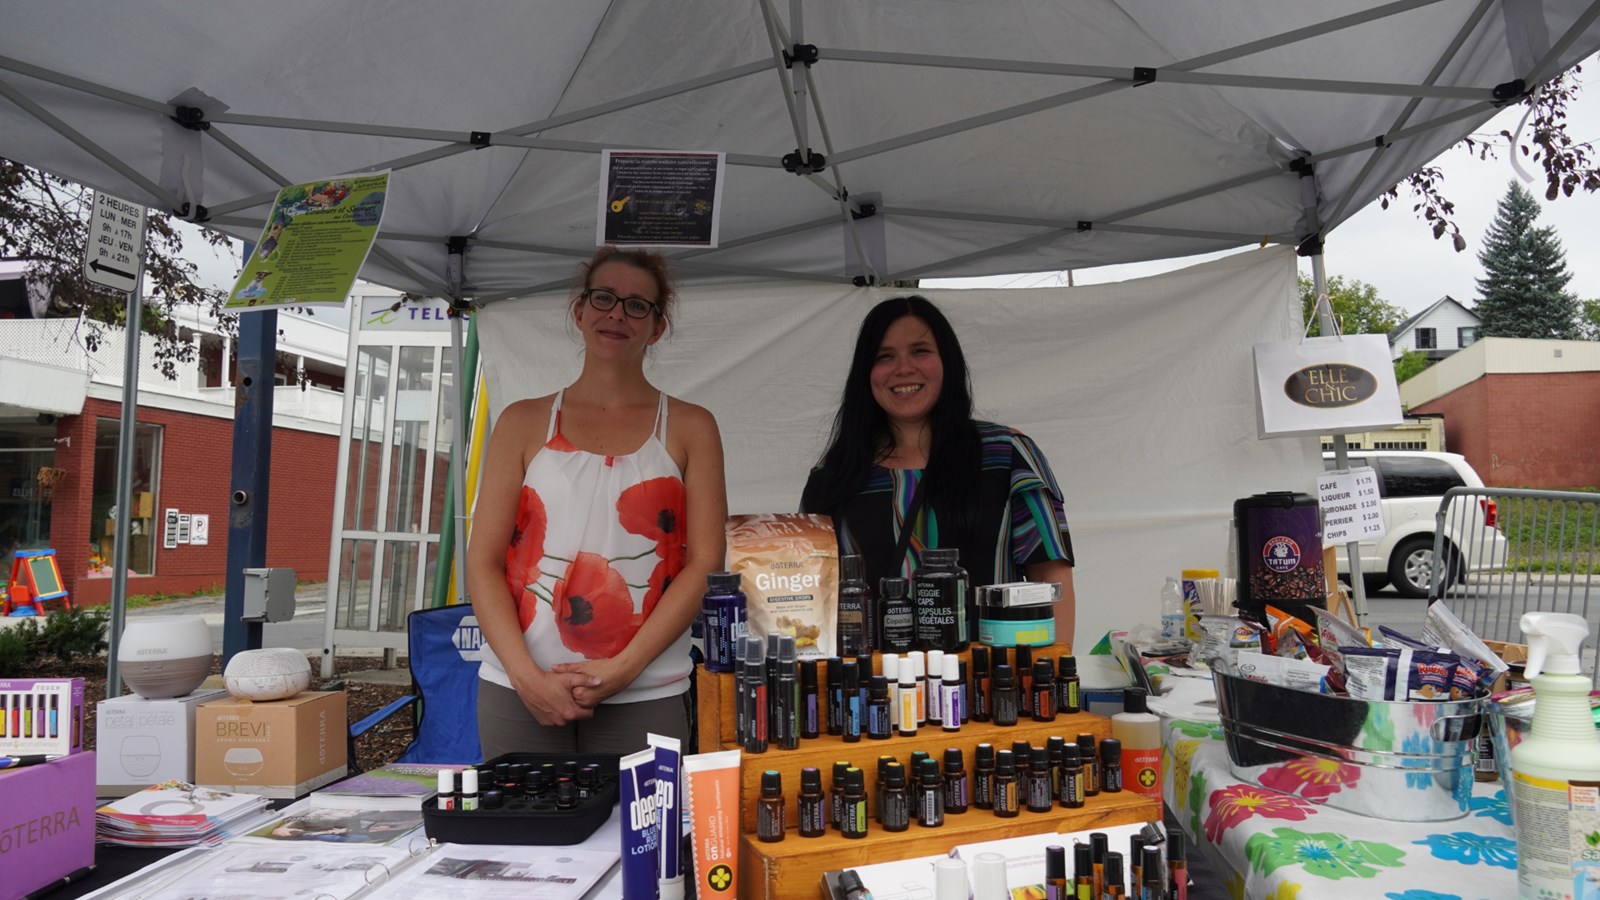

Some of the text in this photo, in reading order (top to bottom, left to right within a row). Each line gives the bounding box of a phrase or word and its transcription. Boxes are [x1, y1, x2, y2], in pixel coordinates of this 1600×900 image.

[99, 194, 139, 218] 2 HEURES
[100, 209, 137, 230] LUN MER
[103, 222, 111, 233] 9h
[121, 229, 132, 240] 17h
[98, 235, 134, 253] JEU VEN
[99, 247, 108, 257] 9h
[117, 253, 130, 264] 21h
[1308, 368, 1349, 384] ELLE
[1325, 381, 1336, 391] &
[1304, 386, 1358, 403] CHIC
[1321, 492, 1351, 502] LIQUEUR
[1325, 516, 1353, 527] PERRIER
[1327, 530, 1347, 539] CHIPS
[755, 572, 822, 592] Ginger
[918, 589, 941, 598] VEGGIE
[917, 597, 935, 606] CAPS
[918, 607, 952, 616] CAPSULES
[216, 722, 266, 736] BREVI
